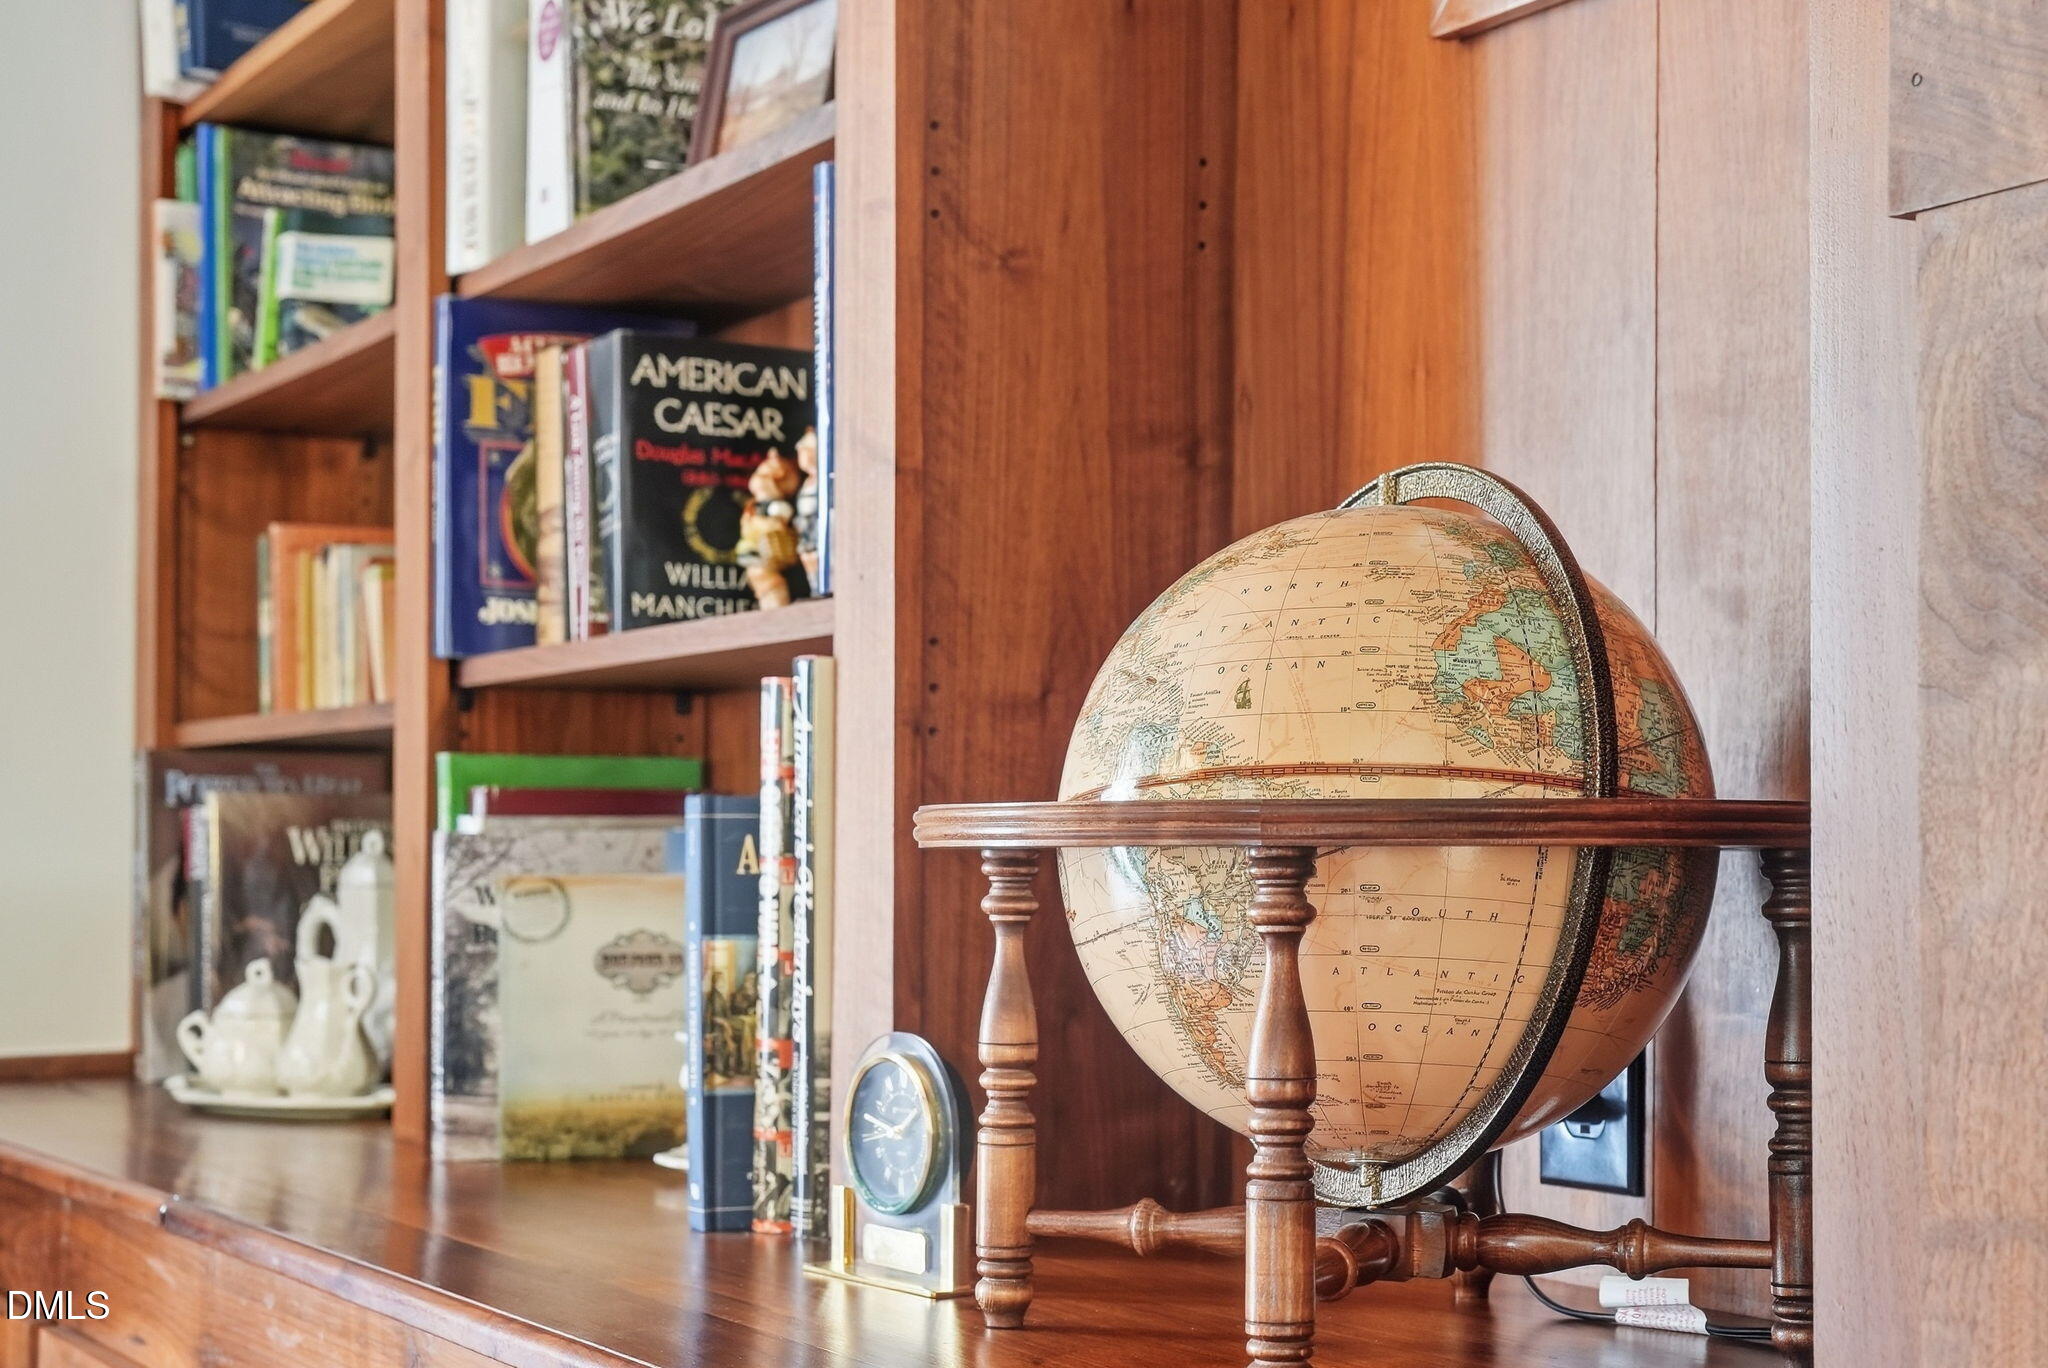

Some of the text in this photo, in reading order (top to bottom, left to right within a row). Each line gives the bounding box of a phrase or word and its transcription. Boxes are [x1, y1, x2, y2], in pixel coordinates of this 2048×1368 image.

[630, 352, 808, 400] AMERICAN
[653, 397, 786, 443] CAESAR
[664, 560, 748, 591] WILLIA
[1240, 579, 1350, 595] NORTH
[630, 590, 758, 620] MANCHE
[1195, 615, 1382, 638] ATLANTIC
[1217, 660, 1326, 675] OCEAN
[1385, 905, 1499, 923] SOUTH
[1332, 966, 1525, 984] ATLANTIC
[1367, 1022, 1481, 1037] OCEAN
